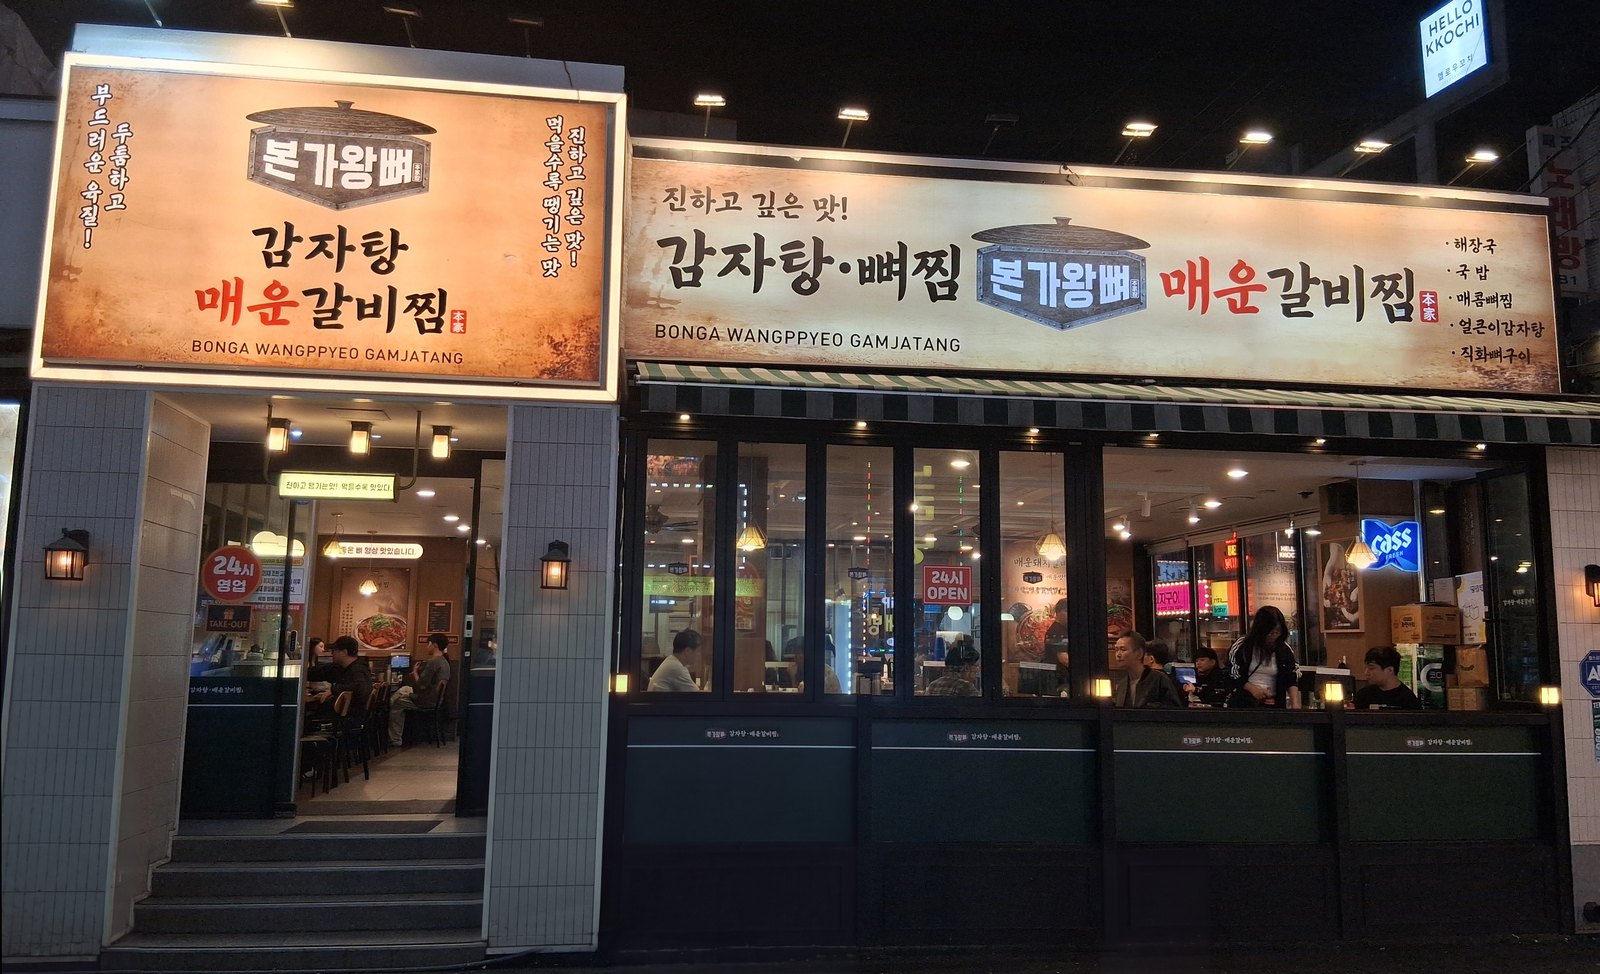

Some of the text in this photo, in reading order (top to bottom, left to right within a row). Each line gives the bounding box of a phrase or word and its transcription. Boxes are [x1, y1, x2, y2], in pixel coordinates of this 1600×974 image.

[1429, 0, 1473, 37] HELLO
[1426, 13, 1480, 57] KKOCHI
[79, 83, 113, 249] 부드러운 육질!
[104, 122, 133, 211] 두툼하고
[262, 138, 414, 190] 본가왕뼈
[541, 115, 565, 277] 먹을수록 땡기는 맛
[564, 126, 587, 267] 진하고 깊은 맛!
[662, 184, 848, 223] 진하고 깊은 맛!
[251, 221, 409, 276] 감자탕
[1454, 236, 1497, 255] 해장국
[990, 259, 1130, 310] 본가왕뼈
[1158, 256, 1415, 325] 매운갈비찜
[1456, 290, 1513, 309] 매콤뼈찜
[194, 276, 449, 336] 매운갈비찜
[1419, 291, 1439, 323] 本家
[451, 310, 467, 334] 本家
[1459, 318, 1545, 338] 얼큰이감자탕
[192, 339, 464, 365] BONGA WANGPPYEO GAMJATANG
[655, 324, 961, 353] BONGA WANGPPYEO GAMJATANG
[1461, 345, 1531, 365] 직화뼈구이
[213, 555, 255, 577] 24시
[1385, 551, 1404, 560] FRESH
[217, 579, 247, 593] 영업
[931, 570, 963, 585] 24시
[927, 586, 968, 600] OPEN
[209, 620, 248, 629] TAKE-OUT
